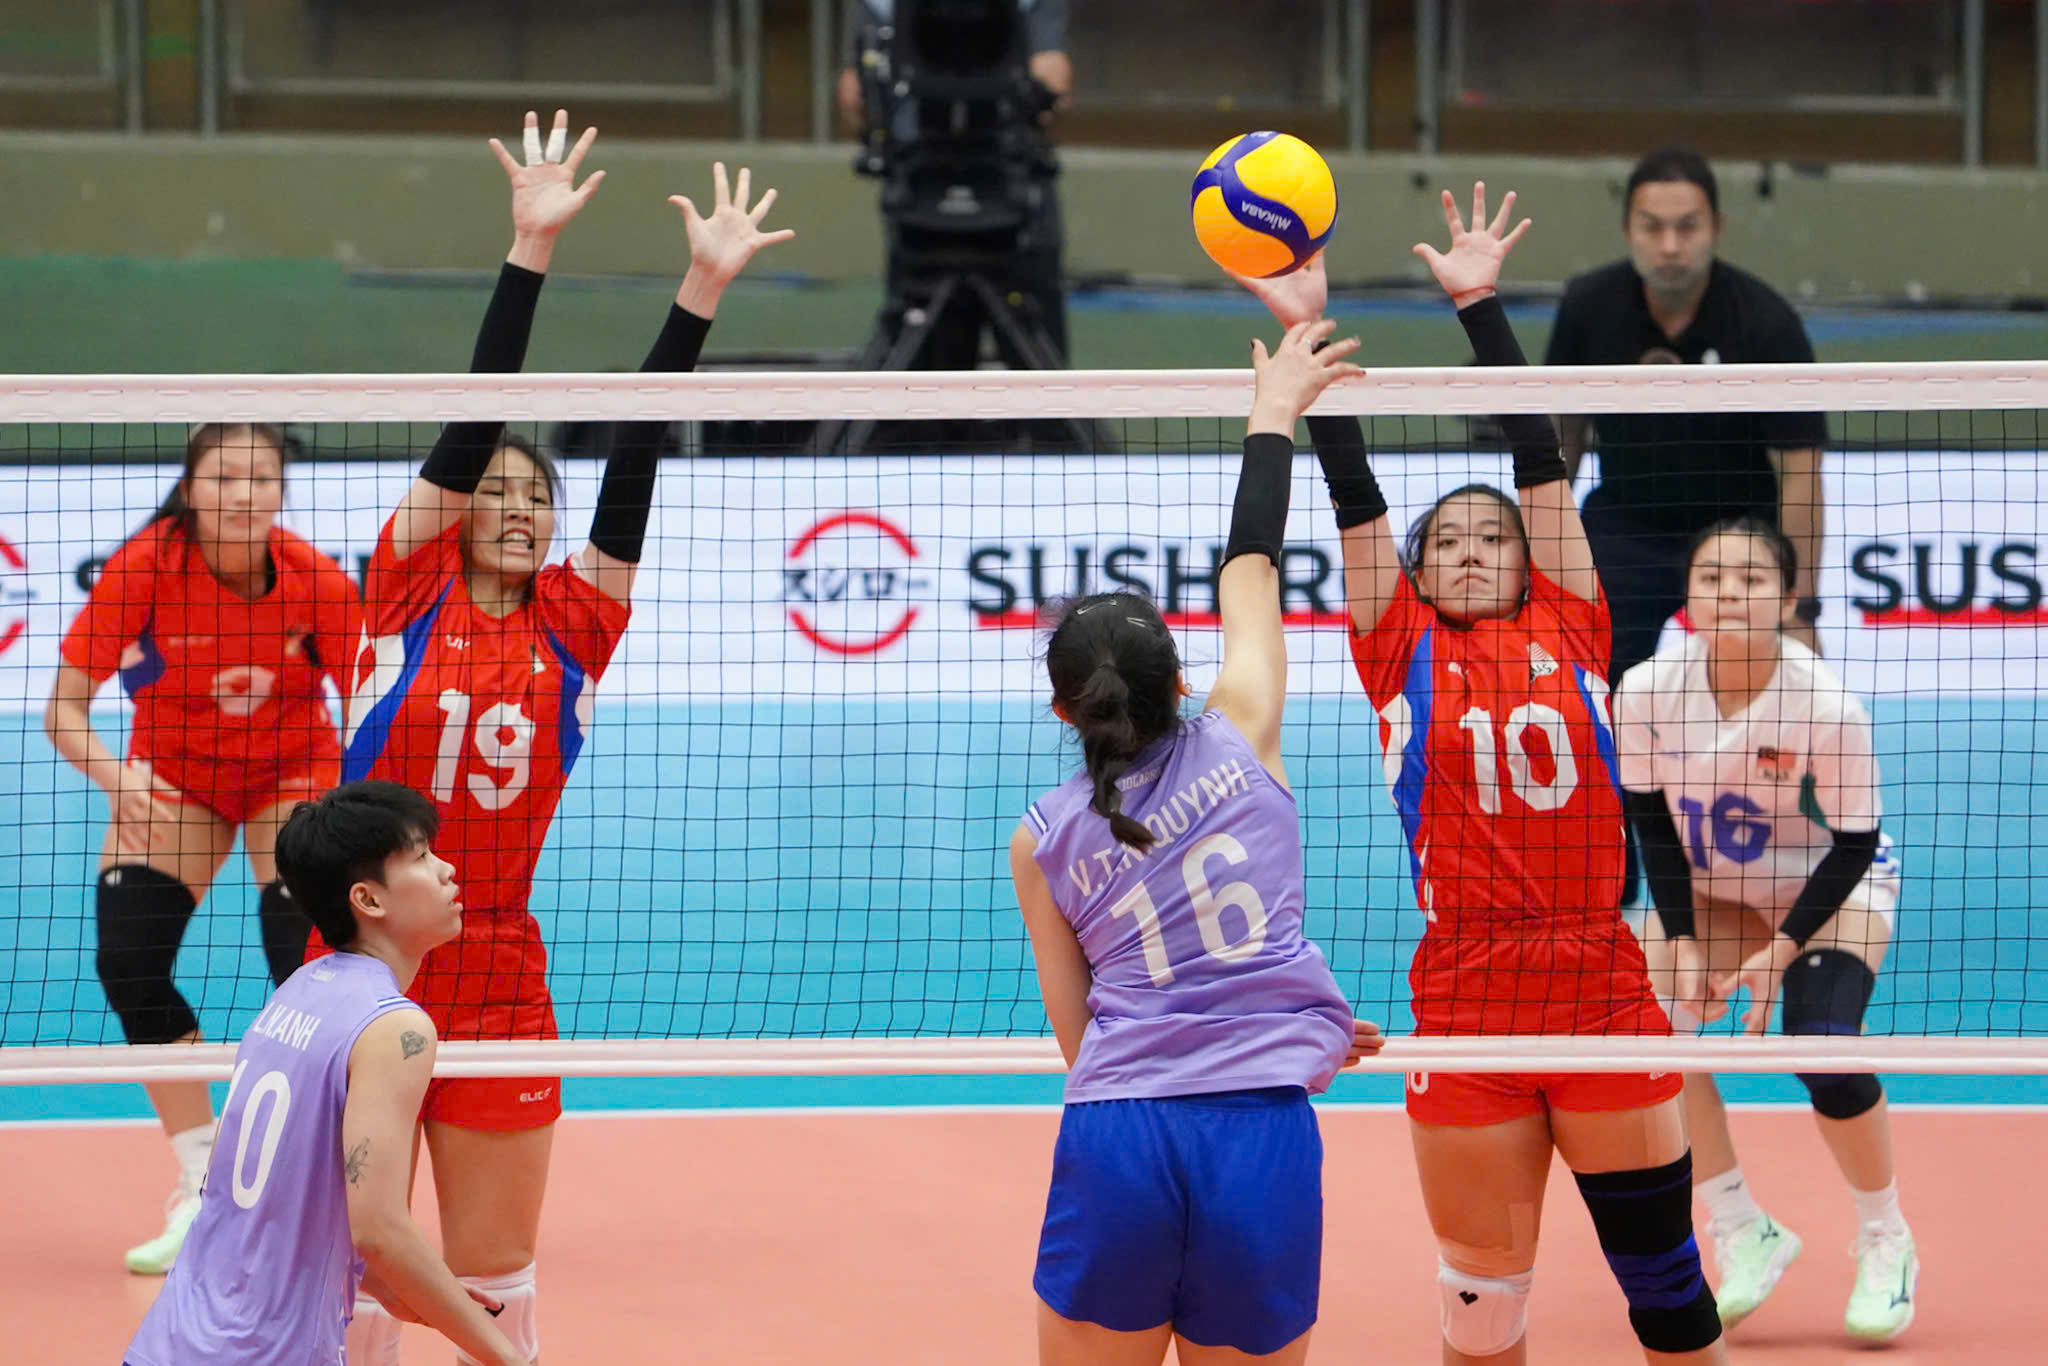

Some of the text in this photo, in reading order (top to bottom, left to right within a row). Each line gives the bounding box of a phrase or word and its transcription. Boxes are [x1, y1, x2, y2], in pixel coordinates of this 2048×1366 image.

[967, 546, 1347, 615] SUSHR
[1851, 543, 2043, 613] SUS
[431, 688, 536, 811] 19
[1458, 701, 1579, 814] 10
[1678, 792, 1772, 870] 16
[1110, 832, 1268, 988] 16
